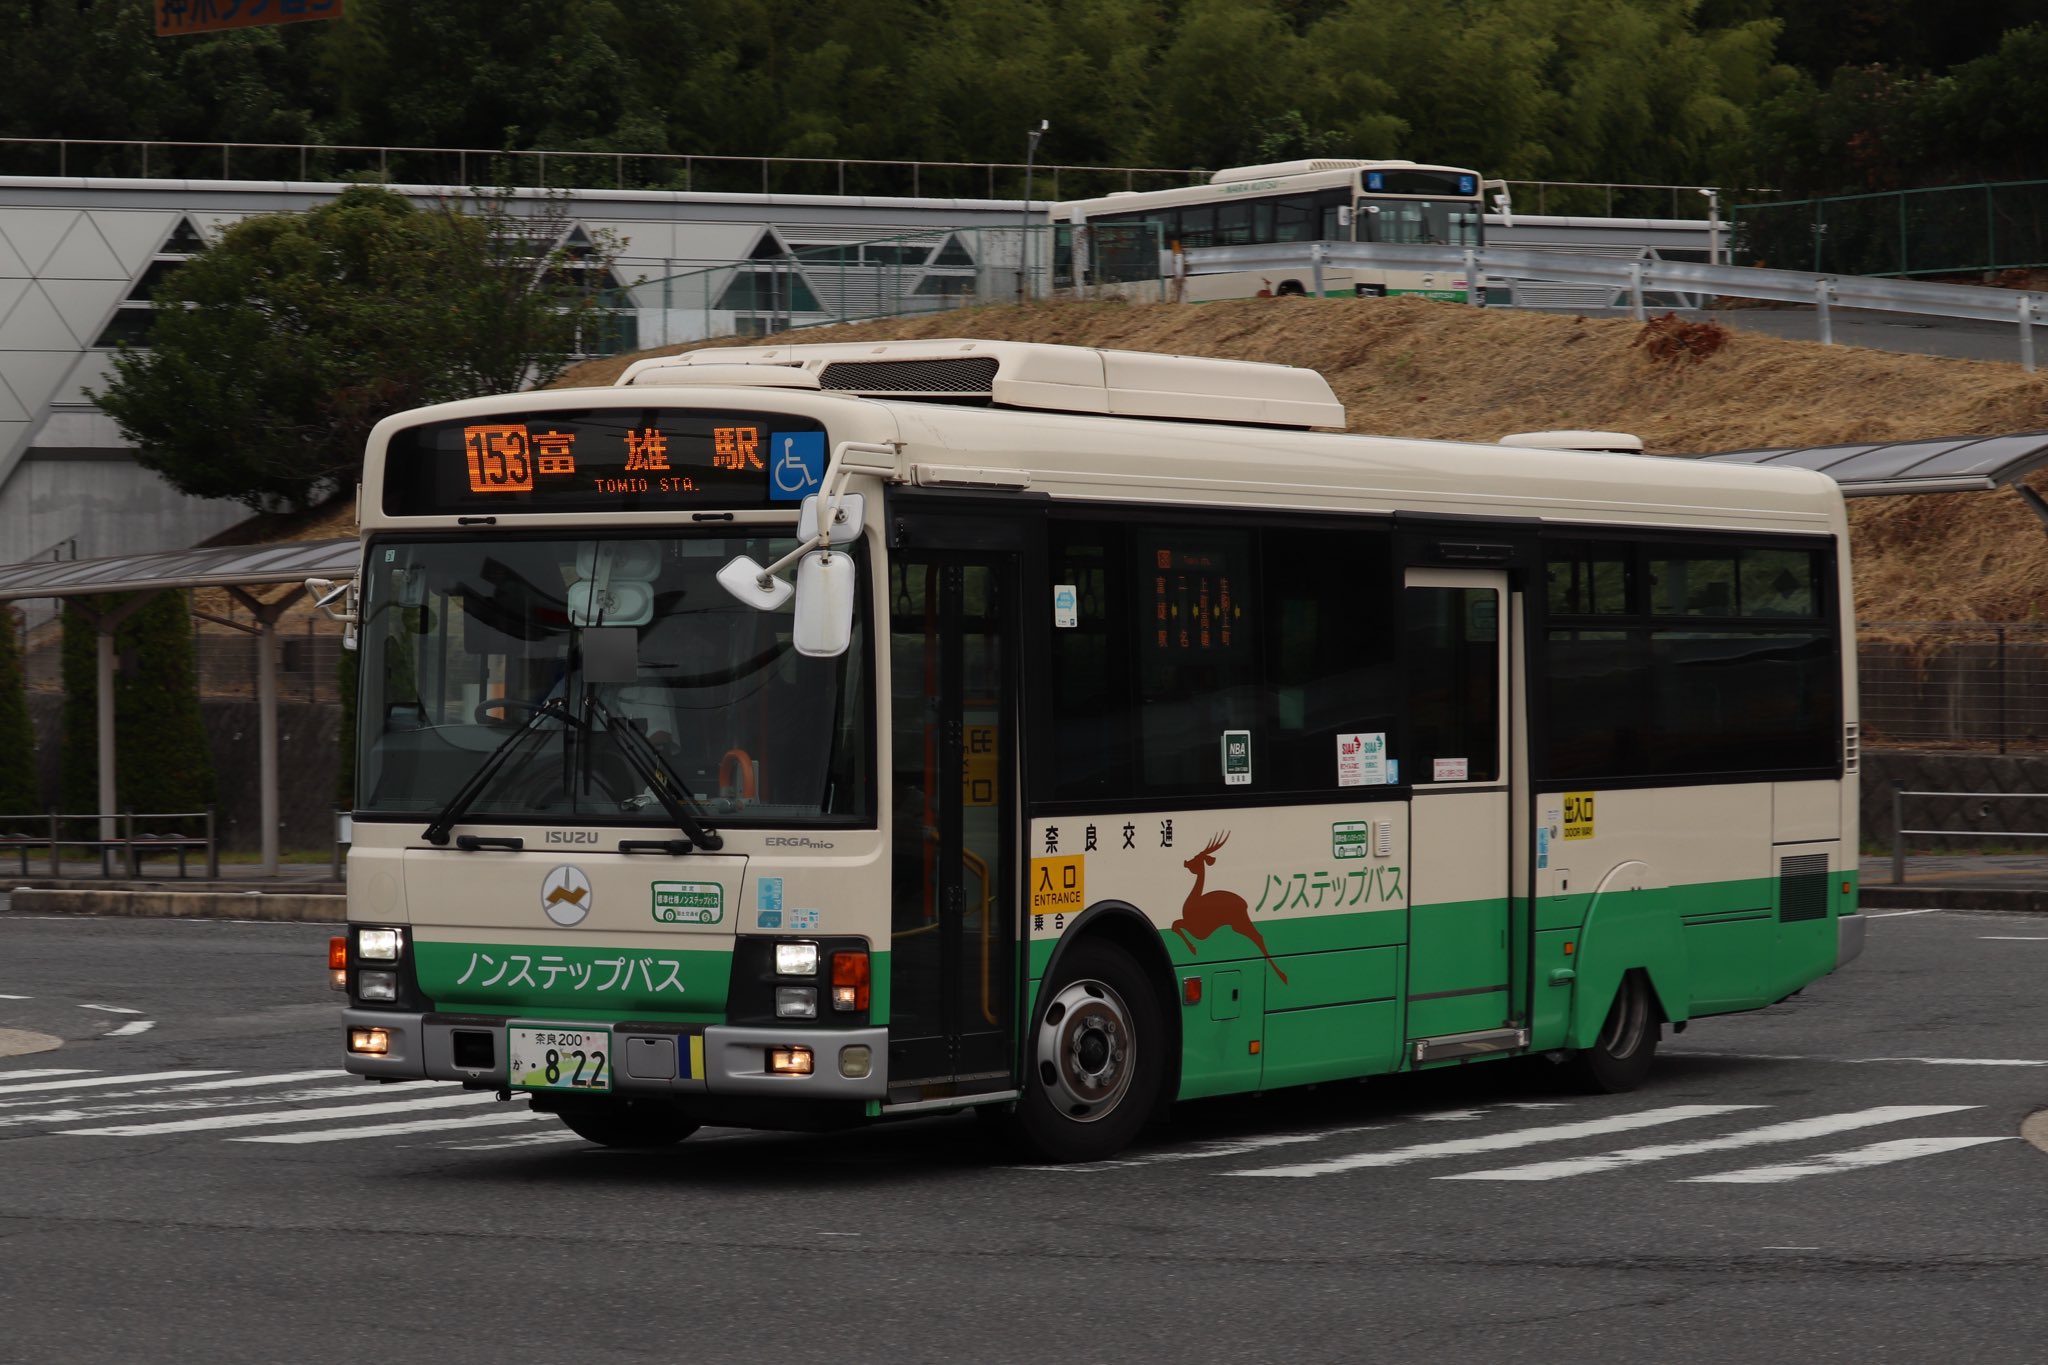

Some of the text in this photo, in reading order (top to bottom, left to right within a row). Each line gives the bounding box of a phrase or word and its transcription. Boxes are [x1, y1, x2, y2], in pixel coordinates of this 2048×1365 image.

[468, 426, 764, 486] 153 富雄駅
[595, 477, 701, 494] TOMIO STA.
[1229, 743, 1246, 755] NBA
[1342, 743, 1355, 755] SIAA
[1364, 742, 1377, 754] SIAA
[1564, 797, 1593, 824] 出入口
[545, 831, 599, 844] ISUZU
[1045, 819, 1174, 854] 奈良交通
[1564, 826, 1593, 837] DOOR WAY
[1039, 865, 1076, 892] 入口
[1255, 865, 1404, 912] ノンステップバス
[1034, 891, 1081, 907] ENTRANCE
[1034, 913, 1065, 931] 乗合
[457, 952, 686, 993] ノンステップバス
[535, 1033, 583, 1047] 奈良200
[513, 1059, 523, 1070] か
